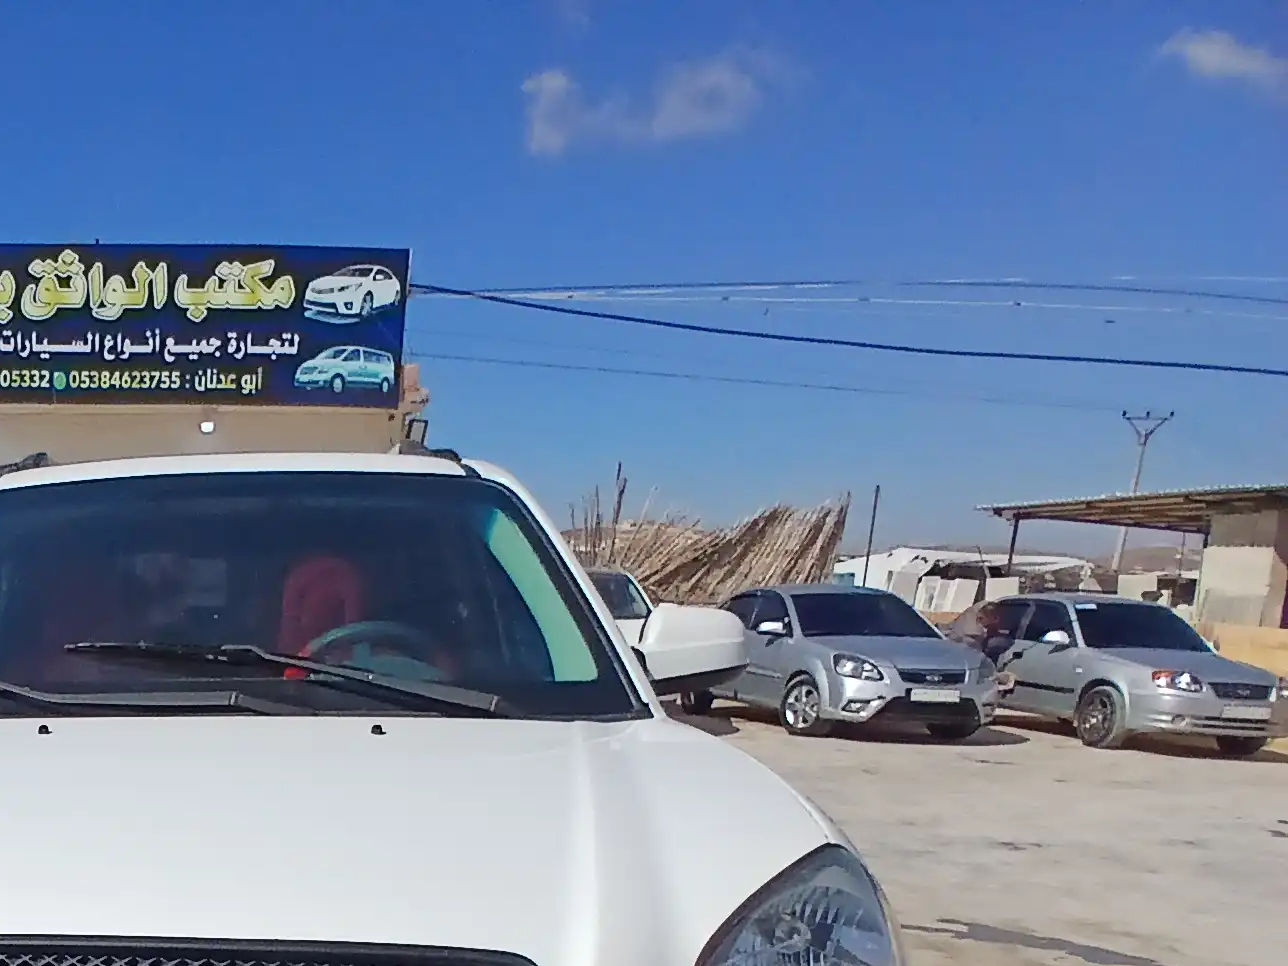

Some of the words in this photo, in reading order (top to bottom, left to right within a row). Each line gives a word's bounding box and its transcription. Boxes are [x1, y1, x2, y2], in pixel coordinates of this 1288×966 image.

[21, 249, 168, 321] الواثق
[174, 259, 296, 322] مكتب
[0, 330, 100, 360] السيارات
[103, 327, 160, 361] أنواع
[164, 336, 222, 362] جميع
[227, 331, 300, 360] لتجارة
[68, 369, 181, 390] 05384623755
[194, 367, 237, 392] عدنان
